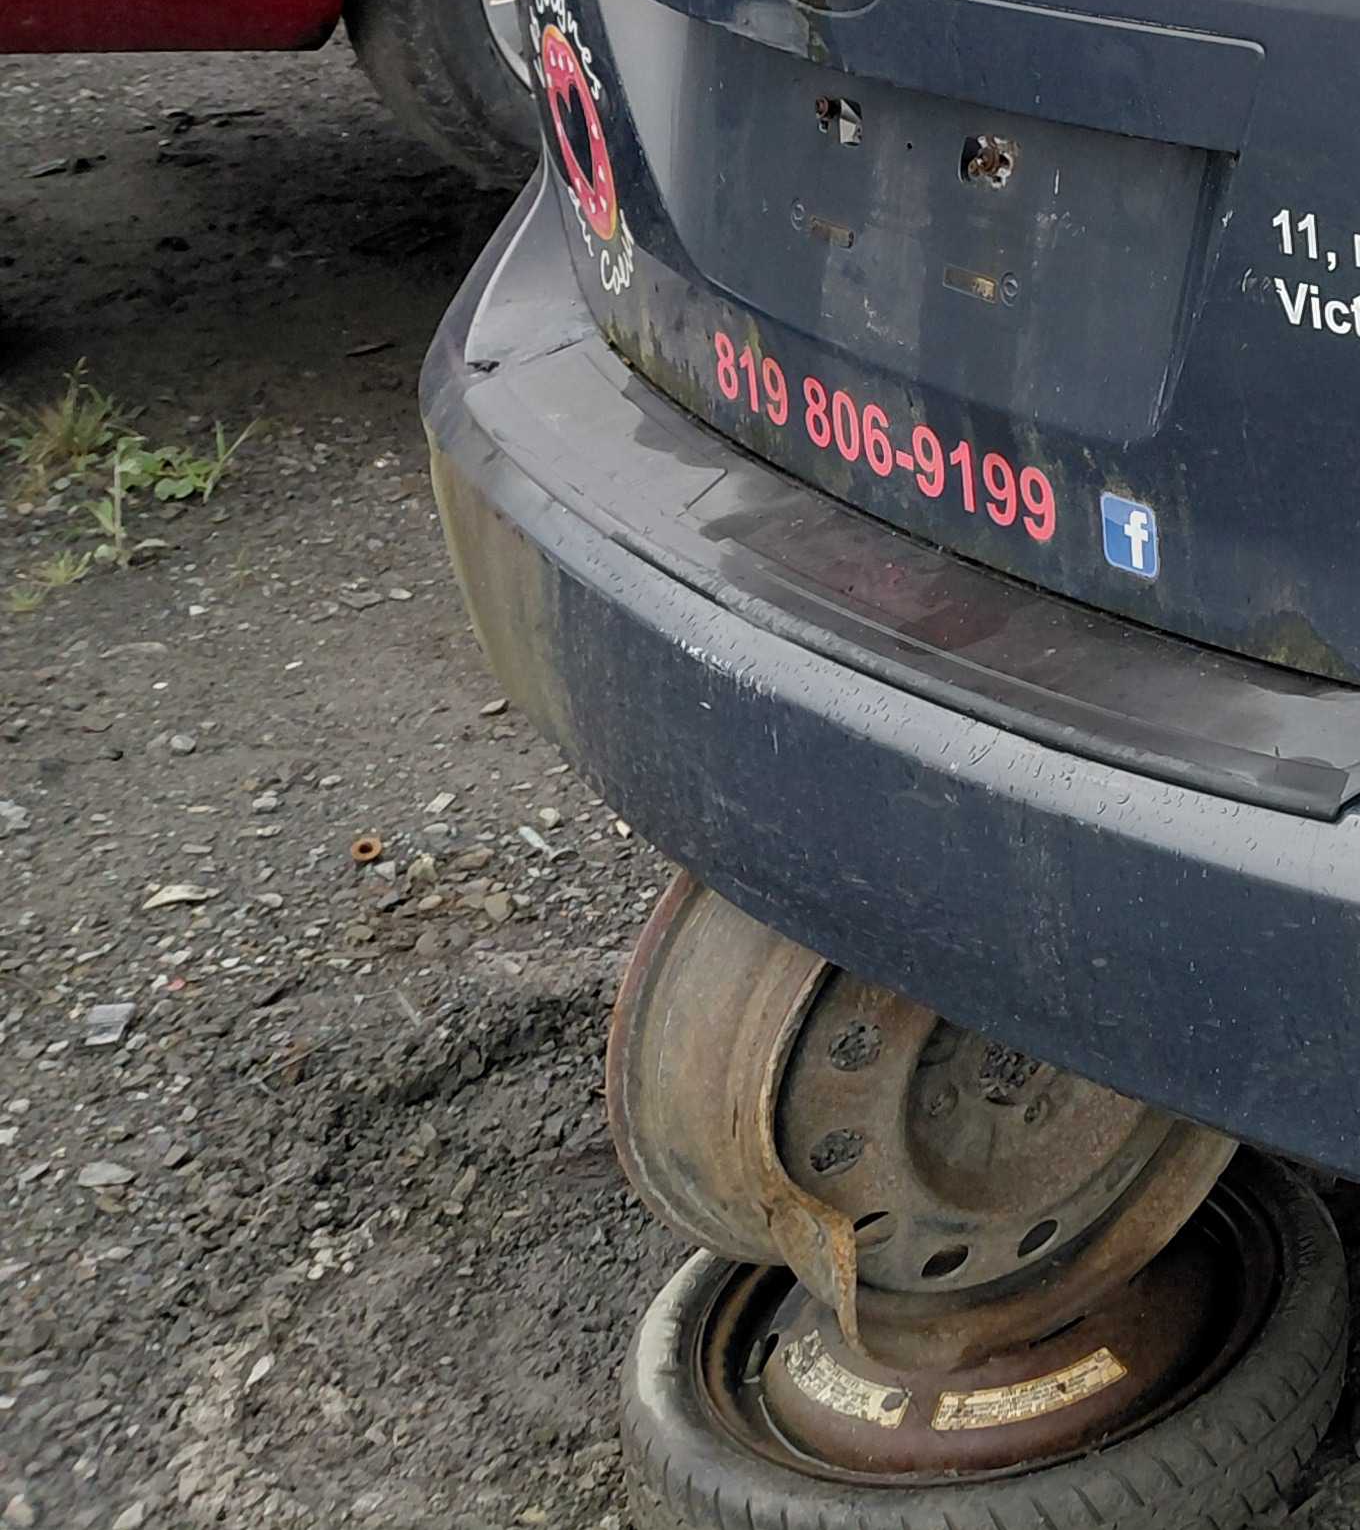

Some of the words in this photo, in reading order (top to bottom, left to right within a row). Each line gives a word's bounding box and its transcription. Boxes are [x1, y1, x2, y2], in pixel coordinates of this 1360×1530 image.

[1271, 208, 1339, 272] 11,
[714, 331, 789, 427] 819
[802, 375, 1057, 543] 806-9199
